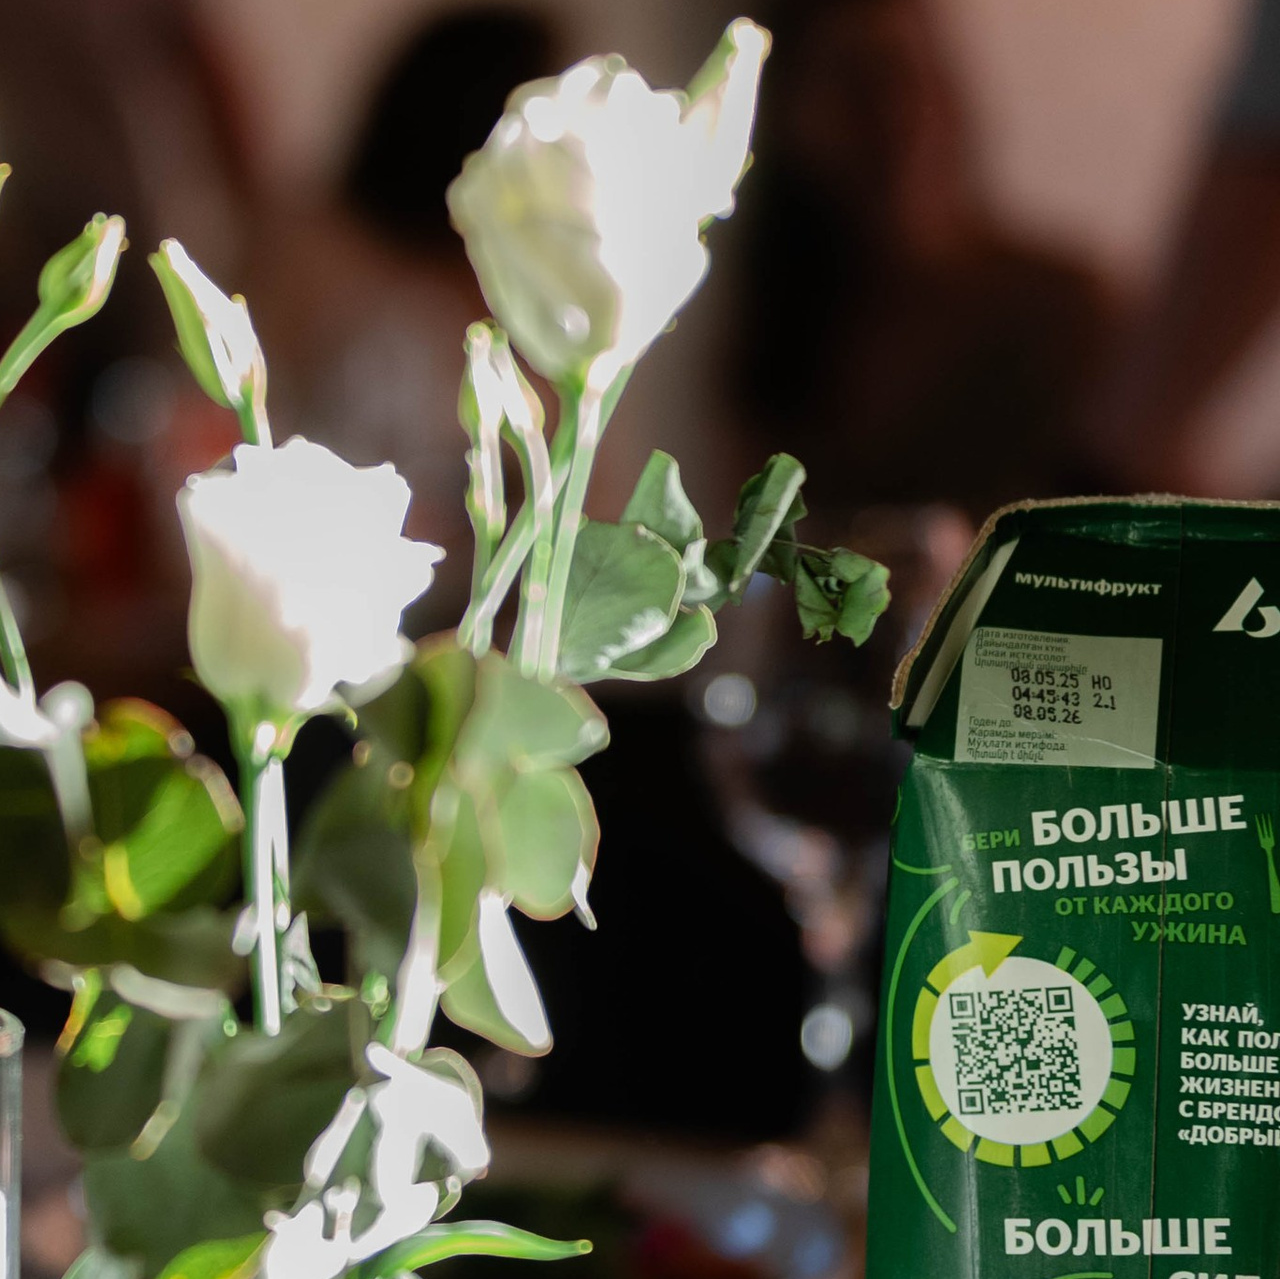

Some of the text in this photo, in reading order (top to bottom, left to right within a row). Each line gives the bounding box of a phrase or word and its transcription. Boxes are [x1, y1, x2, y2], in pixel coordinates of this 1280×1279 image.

[1015, 572, 1163, 597] мультифрукт
[976, 628, 1001, 639] Дата
[1011, 667, 1079, 689] 08.05.25
[1092, 693, 1116, 710] 2.1
[969, 715, 997, 727] Годен
[968, 727, 1016, 739] Жарамды
[961, 795, 1247, 851] БЕРИ БОЛЬШЕ
[992, 848, 1188, 893] ПОЛЬЗЫ
[1054, 892, 1234, 916] ОТ КАЖДОГО
[1132, 921, 1247, 945] УЖИНА
[1181, 1002, 1264, 1027] УЗНАЙ,
[1181, 1027, 1229, 1047] КАК
[1180, 1052, 1279, 1073] БОЛЬШЕ
[1179, 1076, 1280, 1098] ЖИЗНЕН
[1178, 1100, 1194, 1117] С
[1003, 1218, 1232, 1255] БОЛЬШЕ
